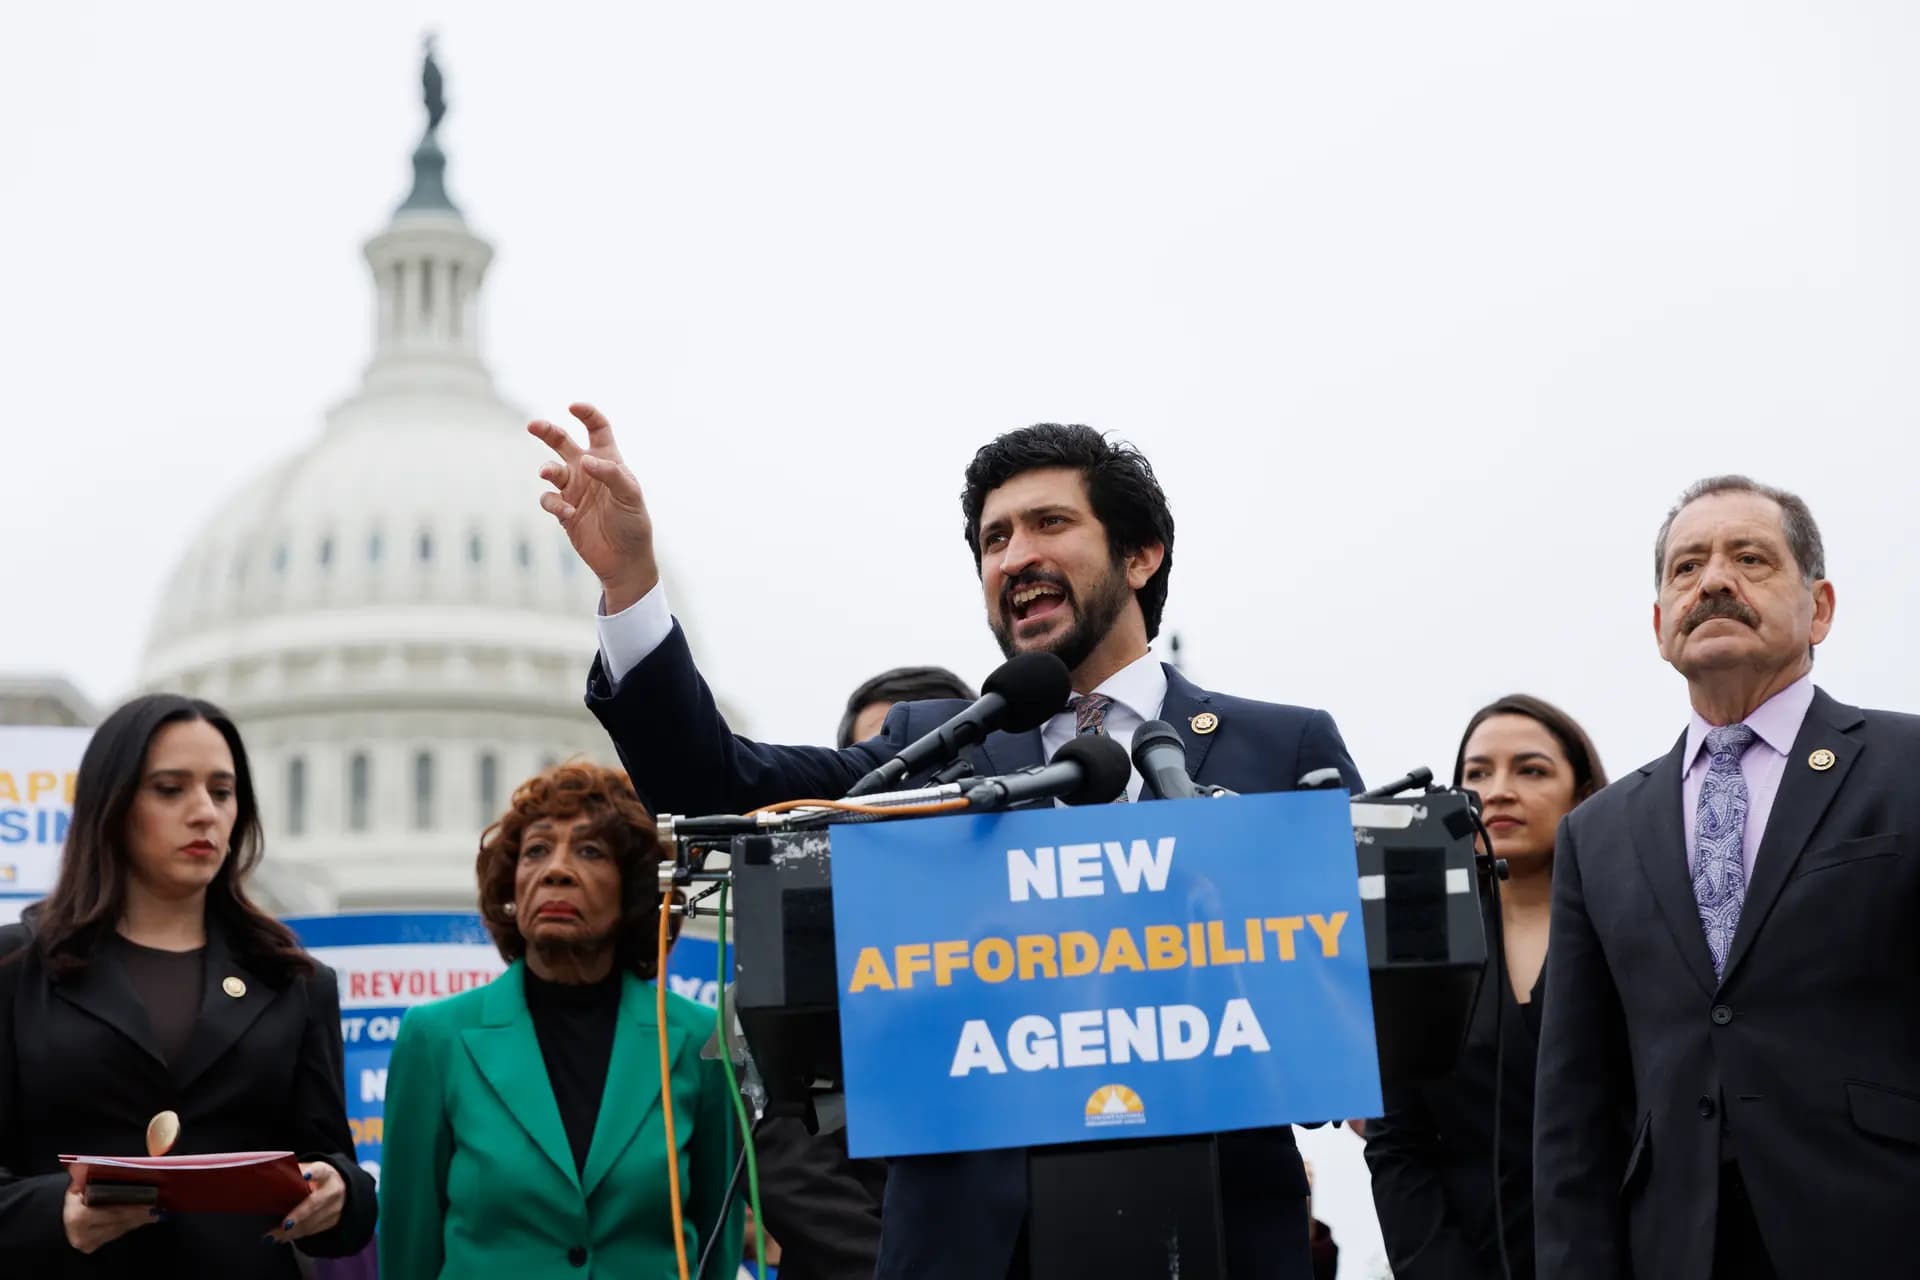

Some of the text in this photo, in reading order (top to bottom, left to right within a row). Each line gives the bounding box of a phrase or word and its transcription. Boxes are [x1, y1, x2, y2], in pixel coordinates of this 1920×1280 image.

[1006, 836, 1176, 902] NEW
[847, 910, 1349, 994] AFFORDABILITY
[949, 998, 1271, 1077] AGENDA
